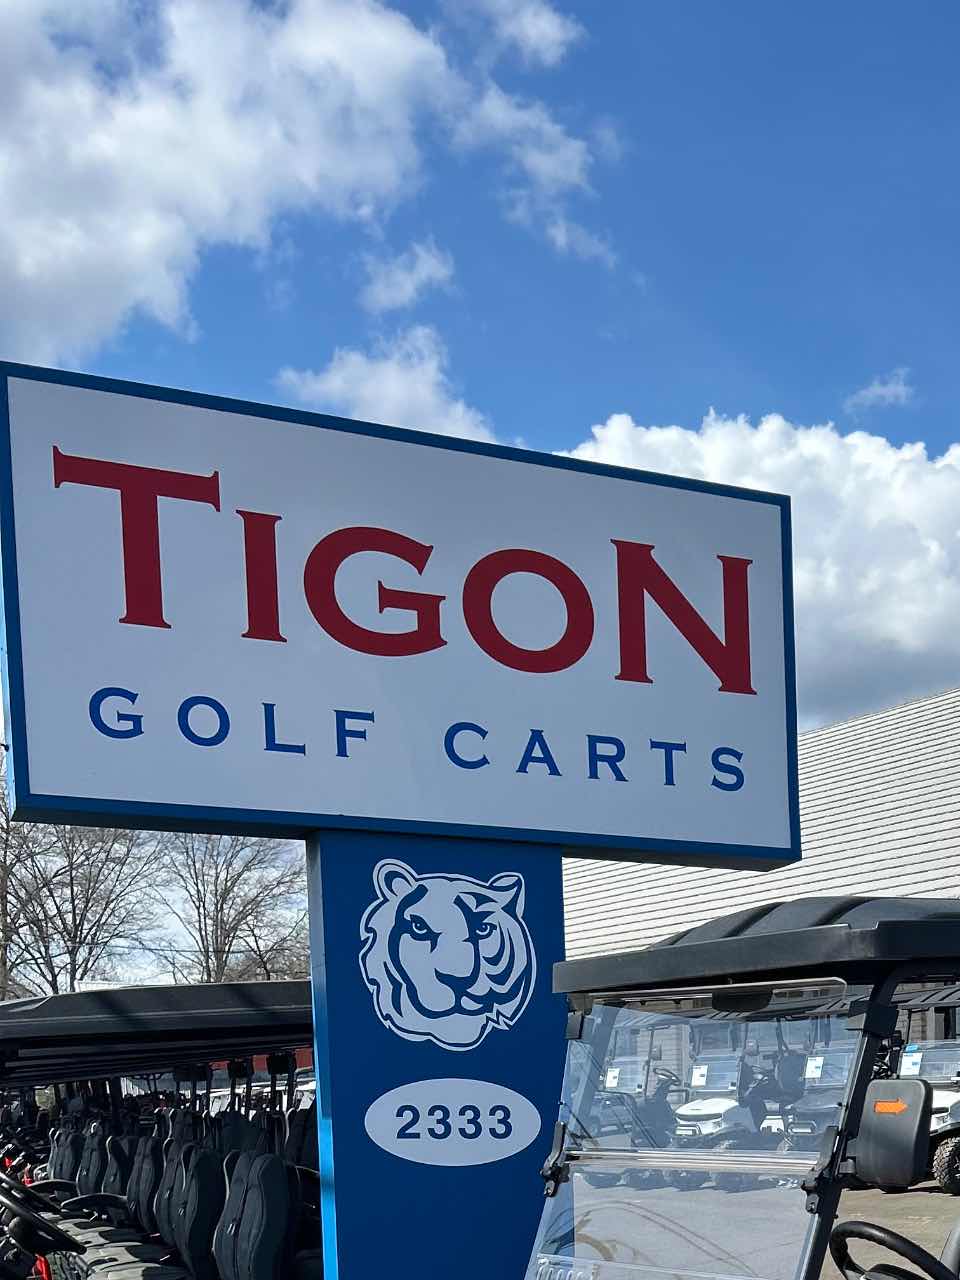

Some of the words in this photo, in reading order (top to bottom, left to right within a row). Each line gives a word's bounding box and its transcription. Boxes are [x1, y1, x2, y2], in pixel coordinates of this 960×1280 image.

[53, 446, 757, 694] TIGON
[88, 686, 375, 758] GOLF
[444, 721, 745, 792] CARTS
[394, 1104, 514, 1140] 2333
